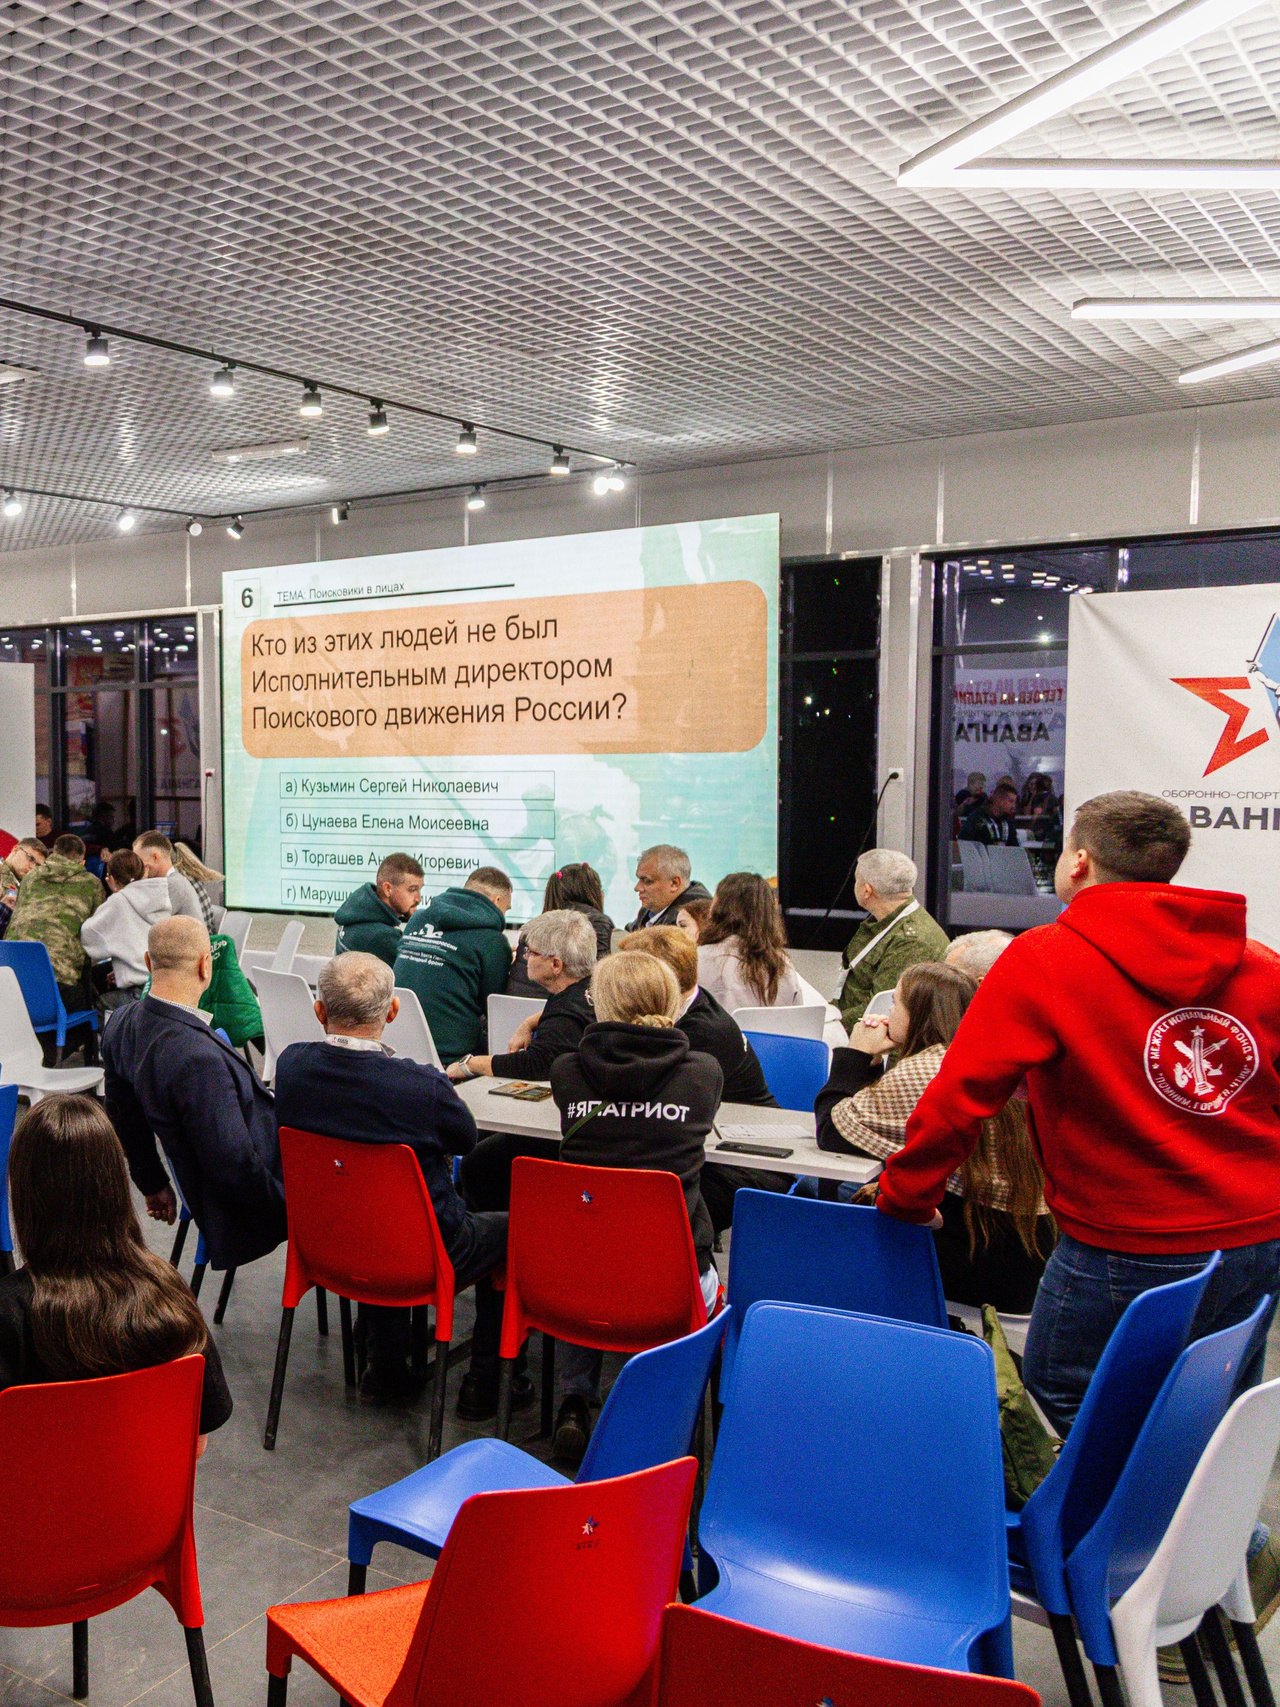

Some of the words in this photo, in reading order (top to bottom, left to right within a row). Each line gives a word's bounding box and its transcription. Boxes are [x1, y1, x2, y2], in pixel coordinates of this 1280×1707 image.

[241, 587, 254, 608] 6
[277, 591, 306, 602] ТЕМА:
[309, 585, 364, 600] Поисковики
[366, 586, 373, 594] в
[375, 582, 405, 594] лицах
[252, 633, 287, 656] Кто
[294, 636, 317, 654] из
[324, 631, 373, 652] этих
[380, 619, 458, 650] людей
[467, 623, 496, 643] не
[505, 614, 558, 641] был
[252, 666, 447, 693] Исполнительным
[454, 657, 612, 689] директором
[253, 706, 377, 729] Поискового
[384, 703, 505, 730] движения
[515, 692, 627, 722] России?
[285, 778, 298, 795] а)
[301, 778, 355, 796] Кузьмин
[359, 777, 407, 796] Сергей
[412, 778, 499, 793] Николаевич
[286, 813, 298, 830] б)
[302, 813, 357, 831] Цунаева
[362, 814, 404, 829] Елена
[408, 814, 489, 831] Моисеевна
[1189, 805, 1280, 831] ВАН
[286, 849, 298, 867] в)
[302, 849, 364, 867] Торгашев
[287, 885, 297, 902] г)
[1230, 1026, 1253, 1054] ФОНД
